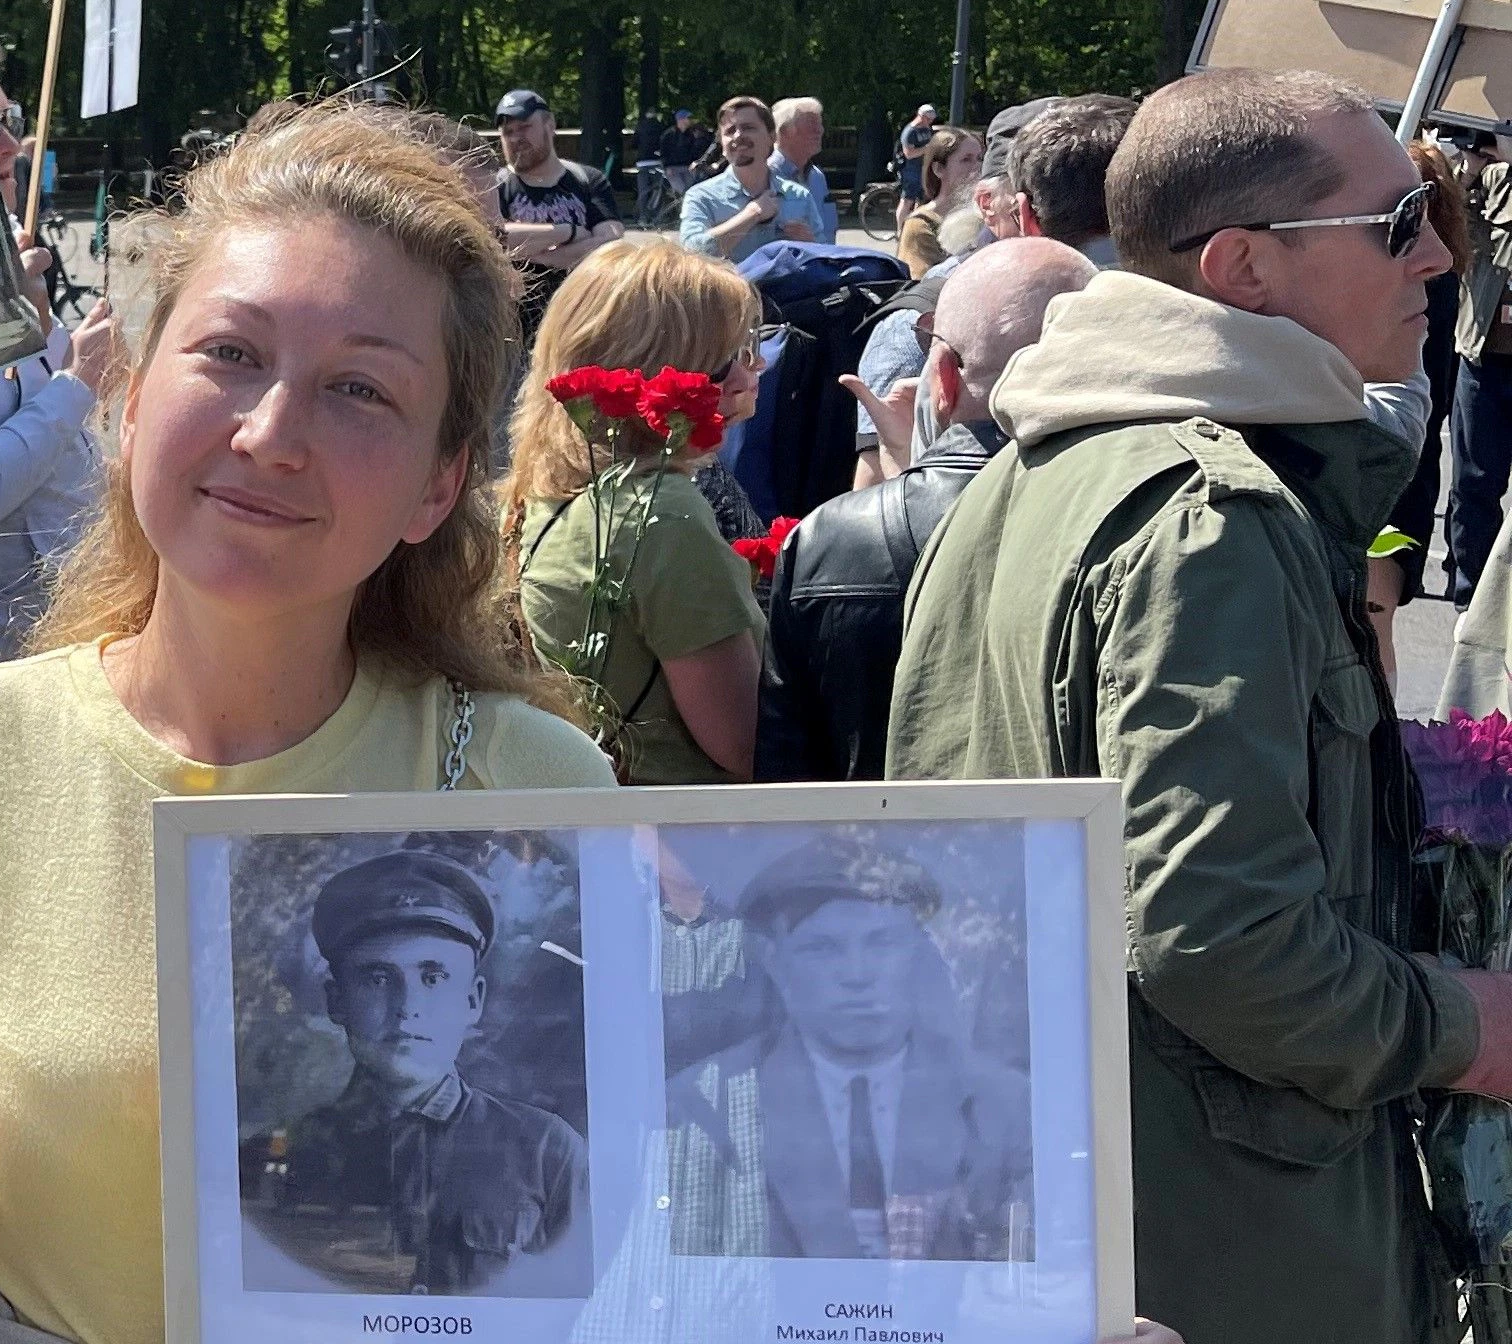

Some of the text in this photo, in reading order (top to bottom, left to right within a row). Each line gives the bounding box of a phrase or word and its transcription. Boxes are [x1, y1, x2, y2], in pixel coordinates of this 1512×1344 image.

[824, 1303, 893, 1319] САЖИН
[363, 1315, 473, 1335] МОРОЗОВ
[776, 1325, 944, 1343] Михаил Павлович
